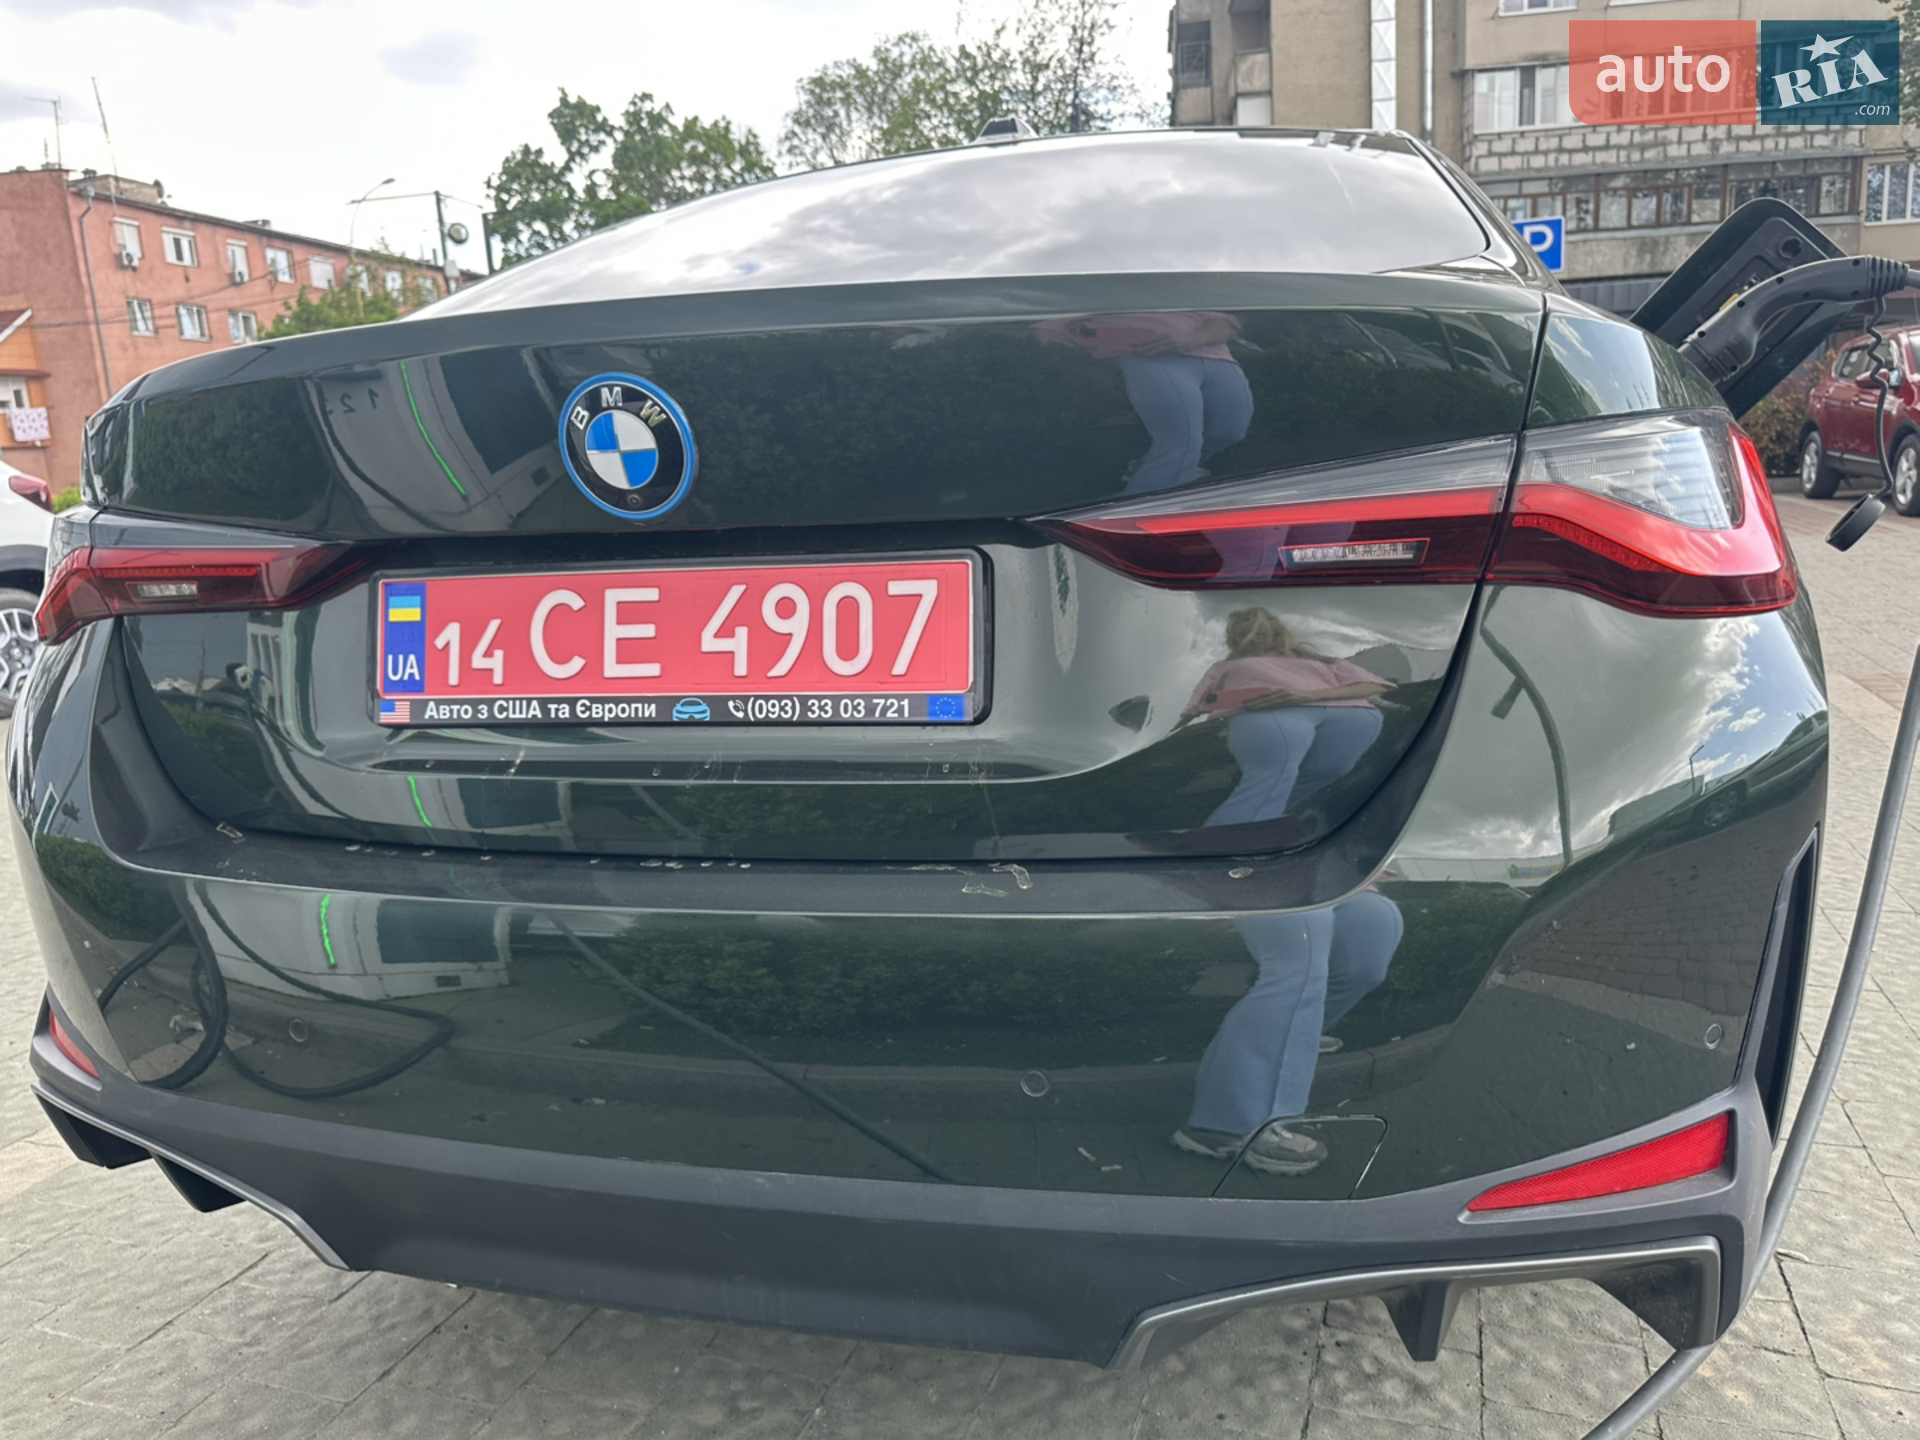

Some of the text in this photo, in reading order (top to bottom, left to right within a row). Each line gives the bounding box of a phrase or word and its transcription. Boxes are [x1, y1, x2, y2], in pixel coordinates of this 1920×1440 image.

[1523, 224, 1554, 253] P
[570, 386, 667, 430] BMW
[387, 579, 939, 686] UA 14 CE 4907
[424, 698, 657, 721] Авто з США та Європи
[747, 696, 910, 722] (093) 33 03 721
